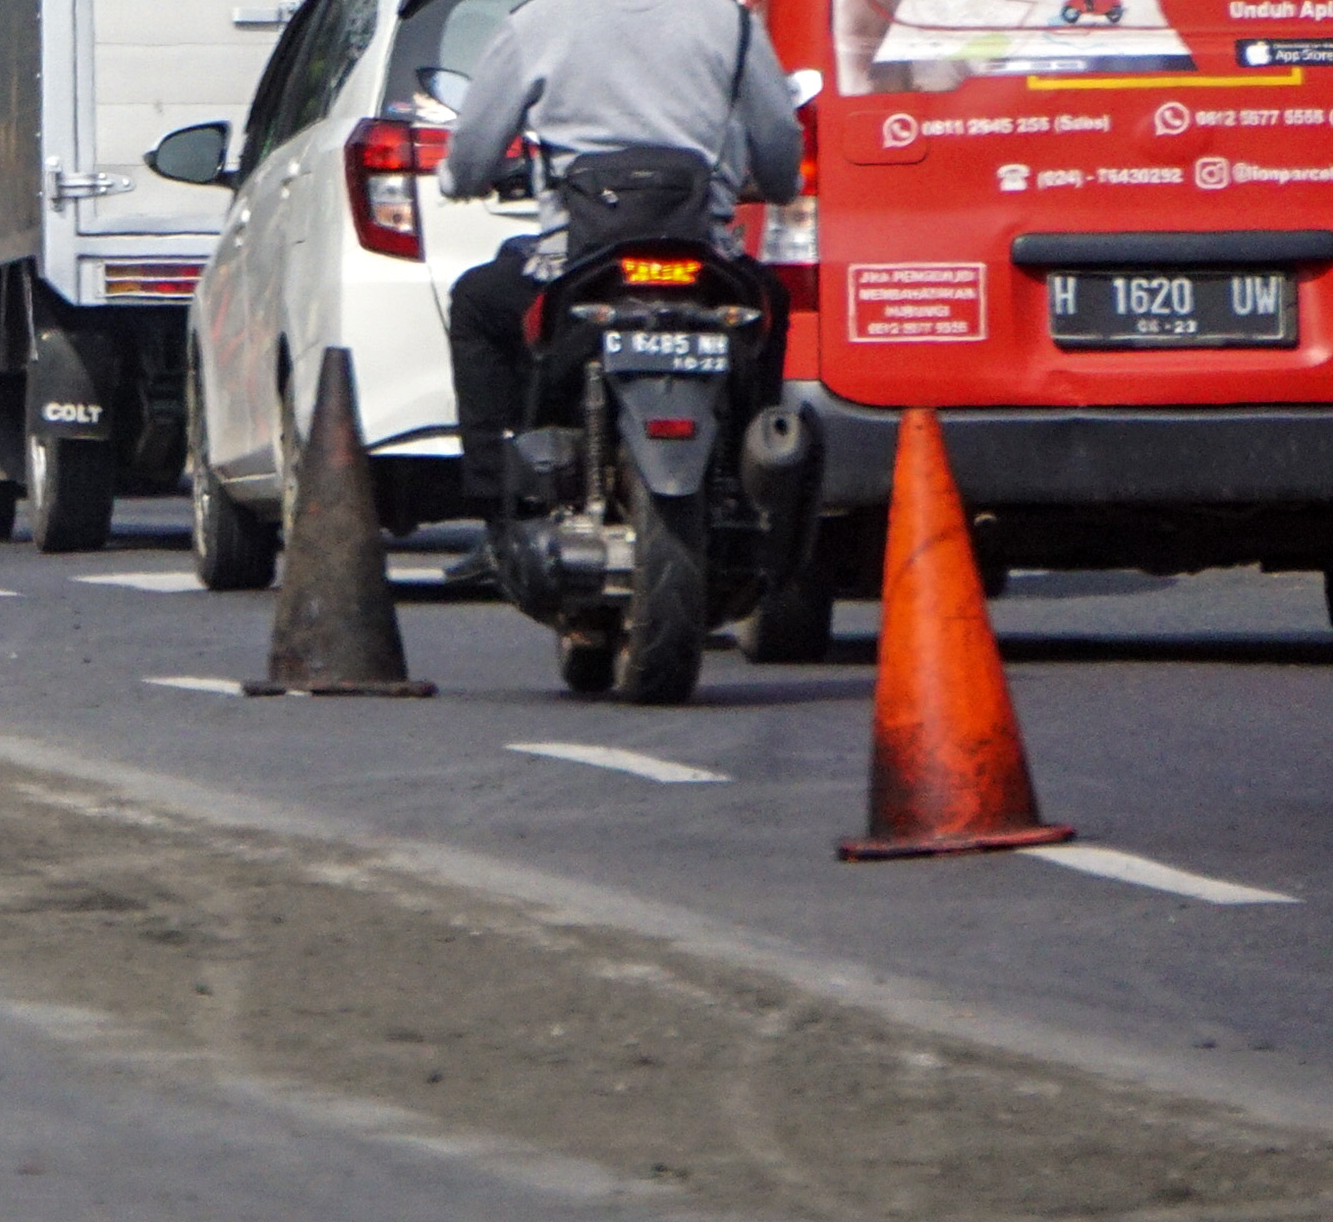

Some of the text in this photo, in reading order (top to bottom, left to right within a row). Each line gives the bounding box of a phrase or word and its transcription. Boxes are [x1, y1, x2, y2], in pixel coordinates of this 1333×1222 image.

[1229, 1, 1296, 19] Unduh
[1275, 50, 1301, 68] App
[1053, 277, 1077, 315] H
[1113, 277, 1193, 315] 1620
[43, 402, 102, 424] COLT
